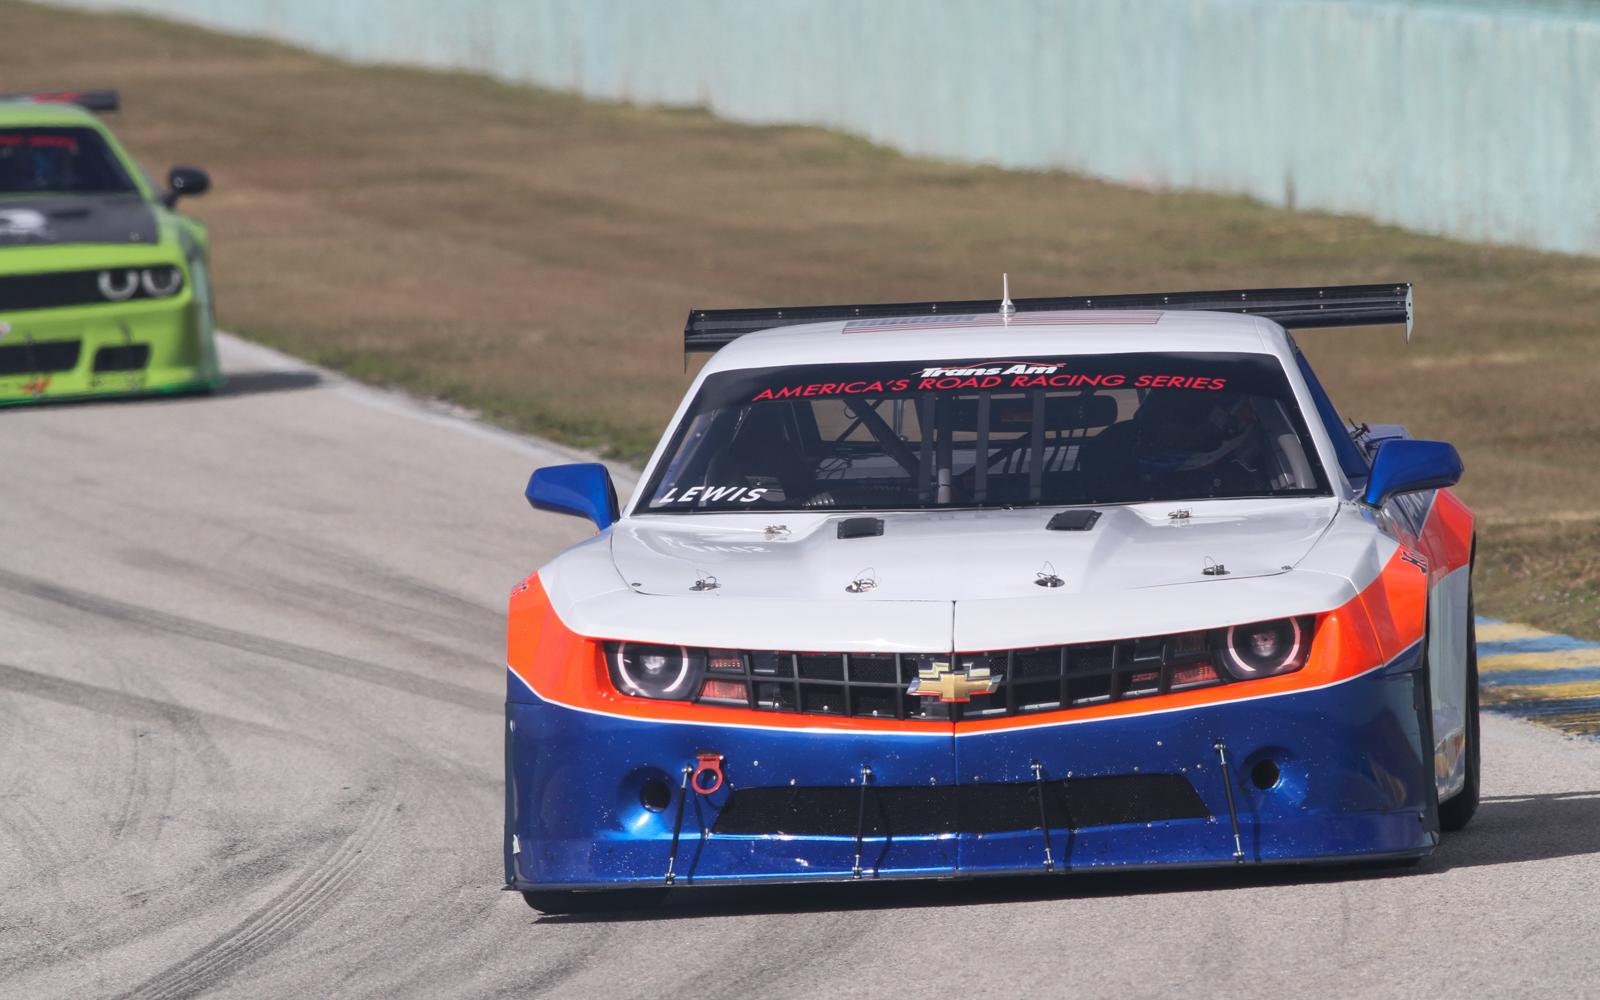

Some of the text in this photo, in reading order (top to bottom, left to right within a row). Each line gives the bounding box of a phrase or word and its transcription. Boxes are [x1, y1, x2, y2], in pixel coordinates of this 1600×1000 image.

[752, 374, 1227, 401] AMERICA'S ROAD RACING SERIES
[659, 486, 769, 503] LEWIS
